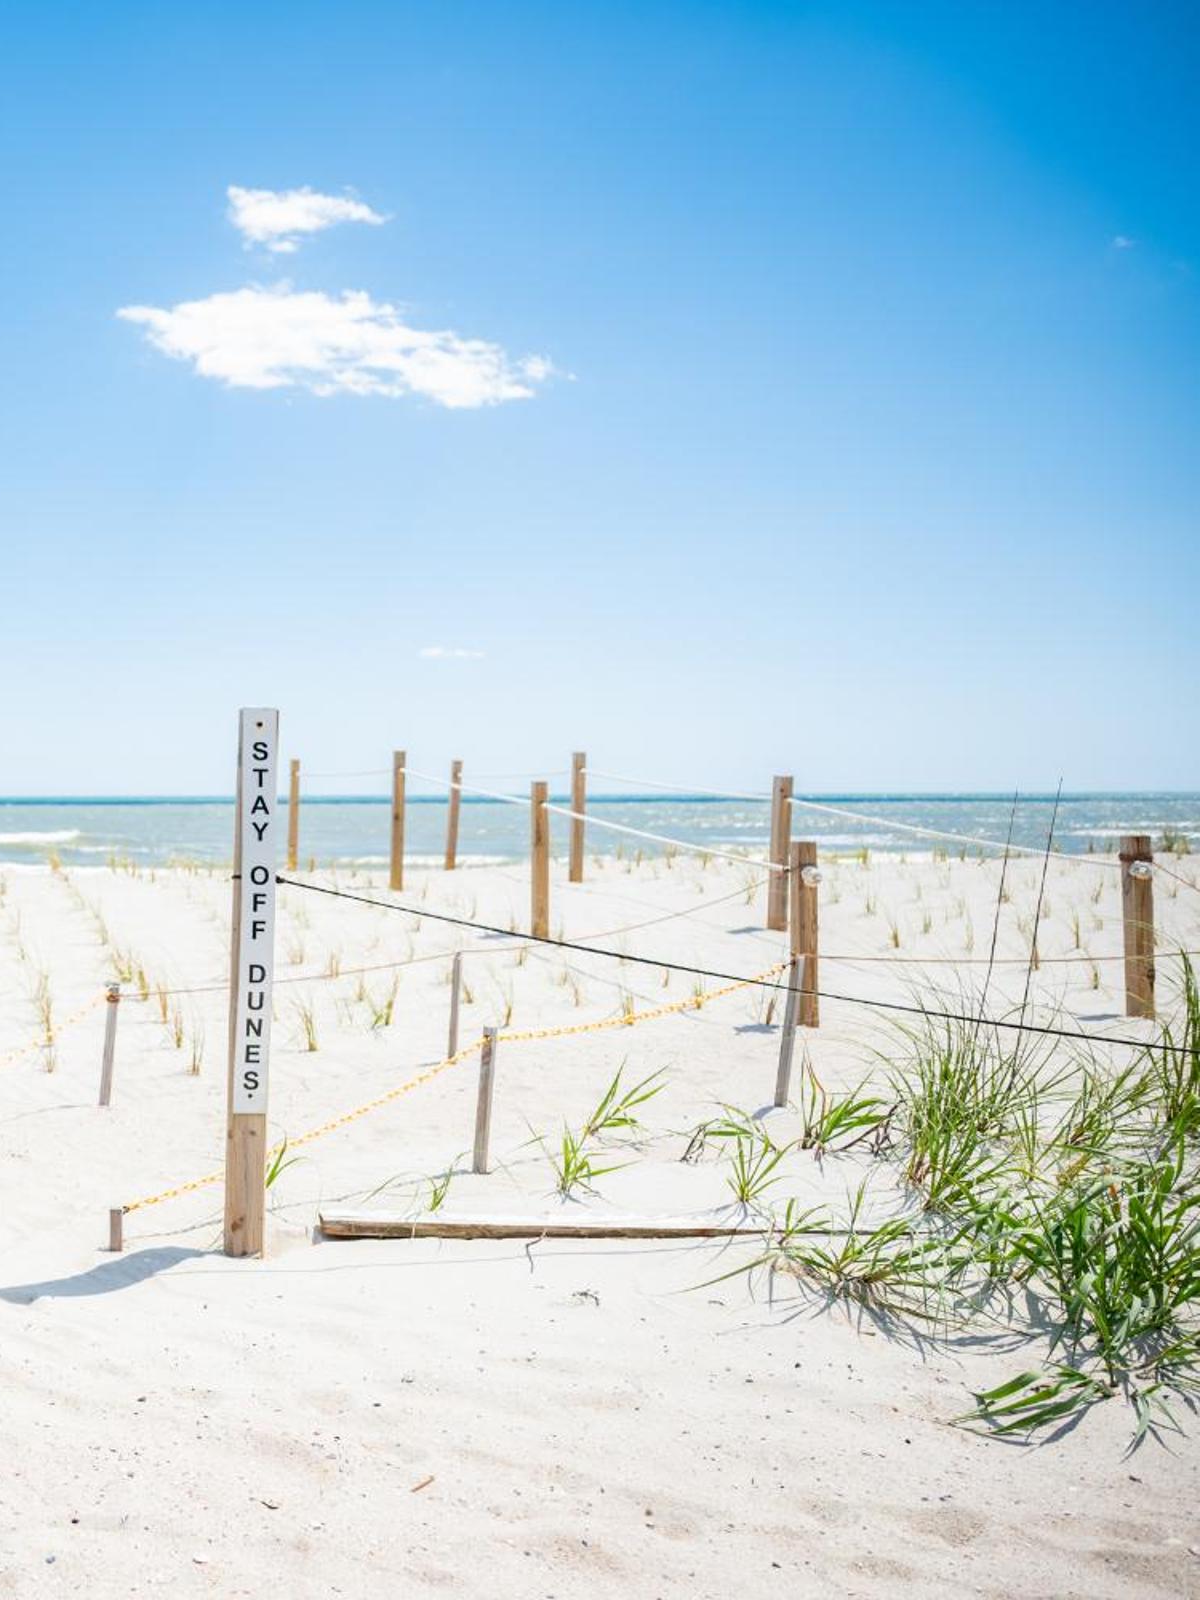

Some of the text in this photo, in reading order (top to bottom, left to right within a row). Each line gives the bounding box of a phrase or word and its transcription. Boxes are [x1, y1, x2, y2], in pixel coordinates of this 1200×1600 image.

[243, 742, 269, 1090] STAY OFF DUNES
